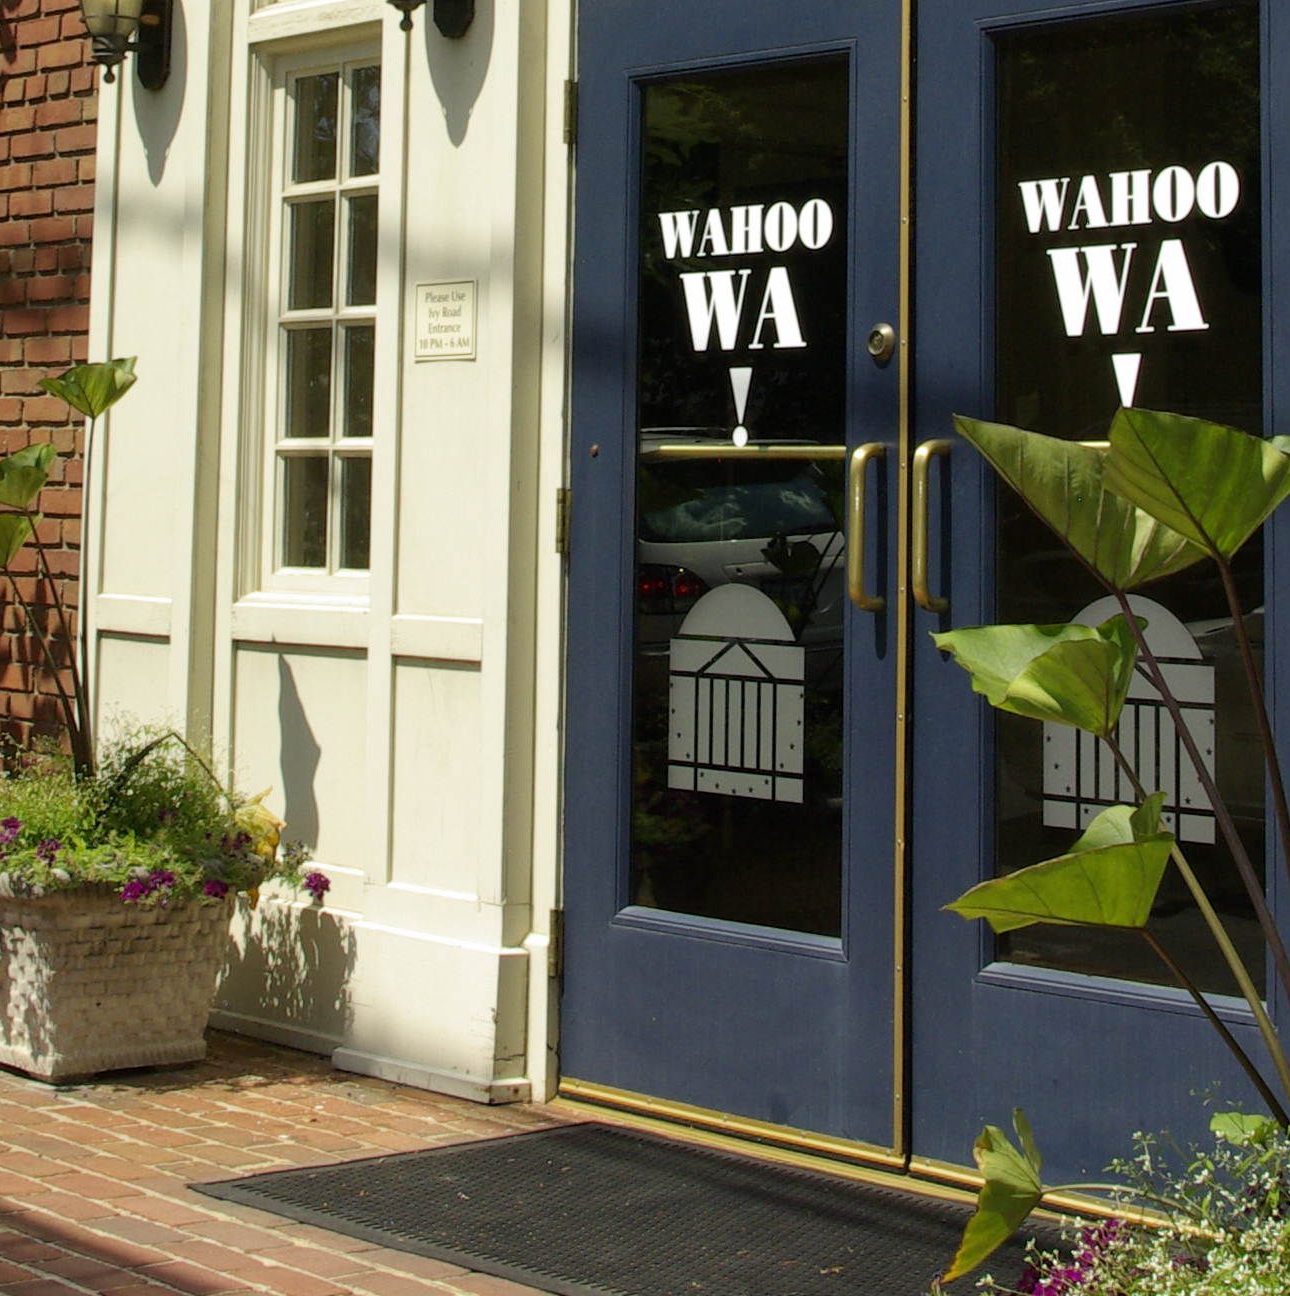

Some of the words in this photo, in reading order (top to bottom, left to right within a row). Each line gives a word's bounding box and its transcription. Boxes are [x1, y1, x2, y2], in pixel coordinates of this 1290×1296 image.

[1018, 161, 1240, 234] WAHOO
[659, 198, 833, 260] WAHOO
[425, 292, 449, 304] Please
[428, 308, 440, 320] Ivy
[442, 305, 462, 317] Road
[679, 266, 807, 352] WA
[1046, 238, 1209, 337] WA
[428, 323, 461, 335] Entrance
